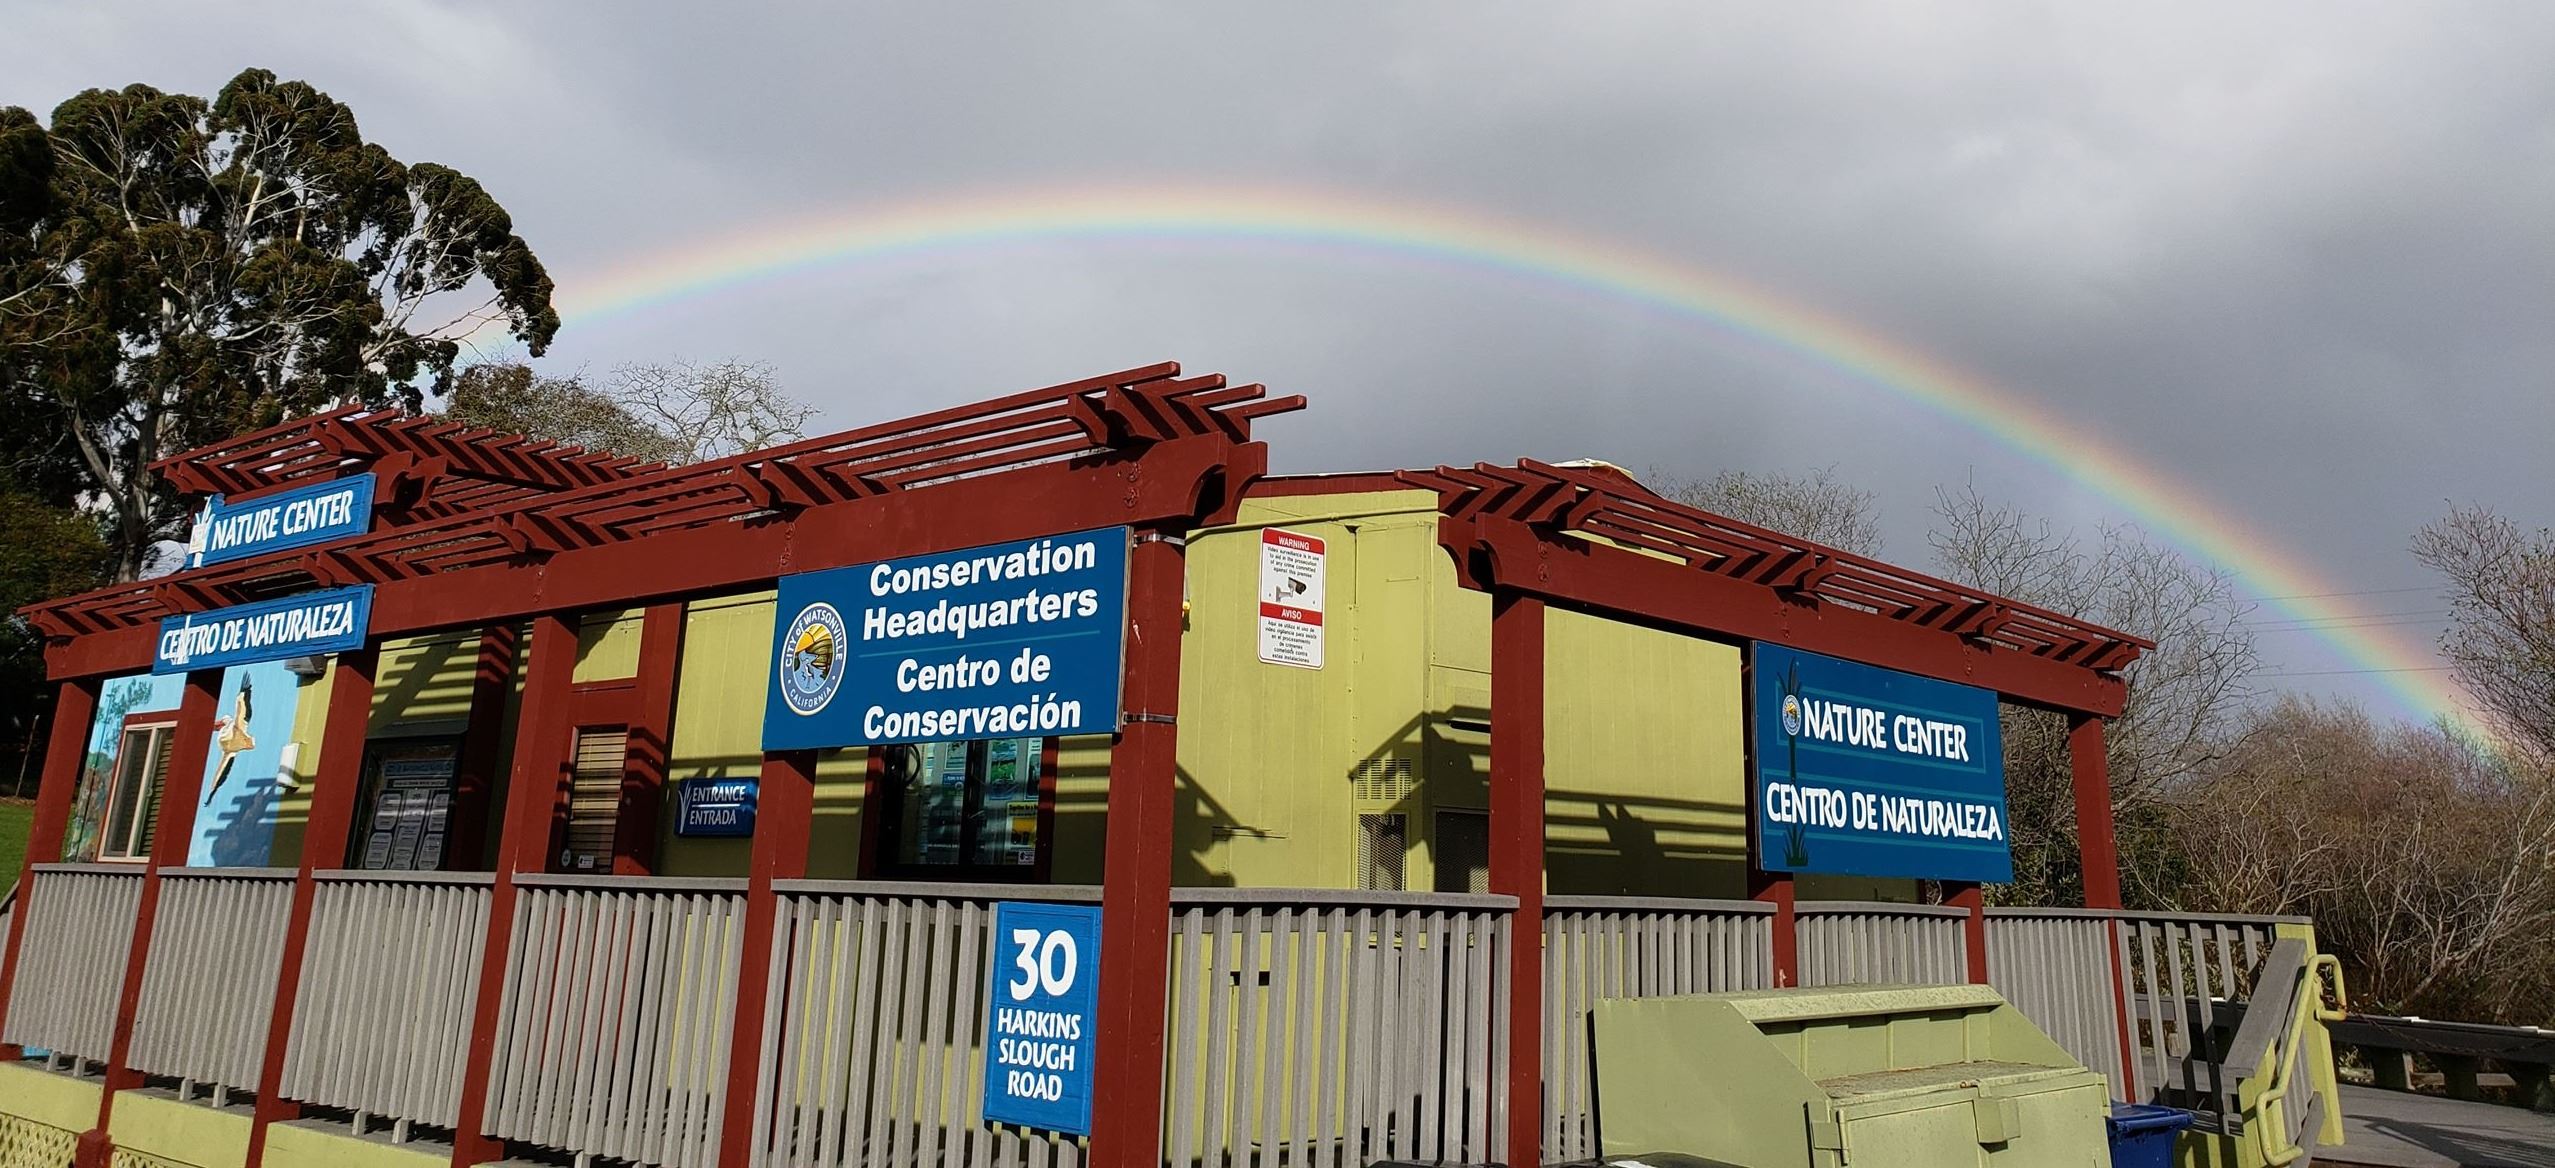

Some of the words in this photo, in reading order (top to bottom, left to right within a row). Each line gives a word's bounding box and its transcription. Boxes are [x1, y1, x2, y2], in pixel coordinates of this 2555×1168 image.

[210, 505, 281, 552] NATURE
[282, 490, 354, 536] CENTER
[1278, 536, 1310, 550] WARNING
[870, 540, 1096, 597] Conservation
[160, 622, 220, 661] CENTRO
[220, 618, 245, 652] DE
[244, 601, 353, 649] NATURALEZA
[863, 588, 1098, 640] Headquarters
[1281, 608, 1302, 620] AVISO
[785, 636, 796, 667] CITY
[803, 609, 843, 660] WATSONVILLE
[896, 654, 1000, 693] Centro
[1010, 647, 1051, 684] de
[790, 686, 832, 707] CALIFORNIA
[863, 692, 1081, 740] Conservación
[1802, 698, 1887, 749] NATURE
[1893, 714, 1969, 762] CENTER
[689, 809, 737, 825] ENTRADA
[691, 785, 746, 802] ENTRANCE
[1766, 782, 1847, 828] CENTRO
[1852, 791, 1878, 830] DE
[1880, 795, 2003, 841] NATURALEZA
[1010, 928, 1077, 1001] 30
[997, 1007, 1081, 1040] HARKINS
[998, 1038, 1075, 1071] SLOUGH
[1007, 1069, 1063, 1102] ROAD
